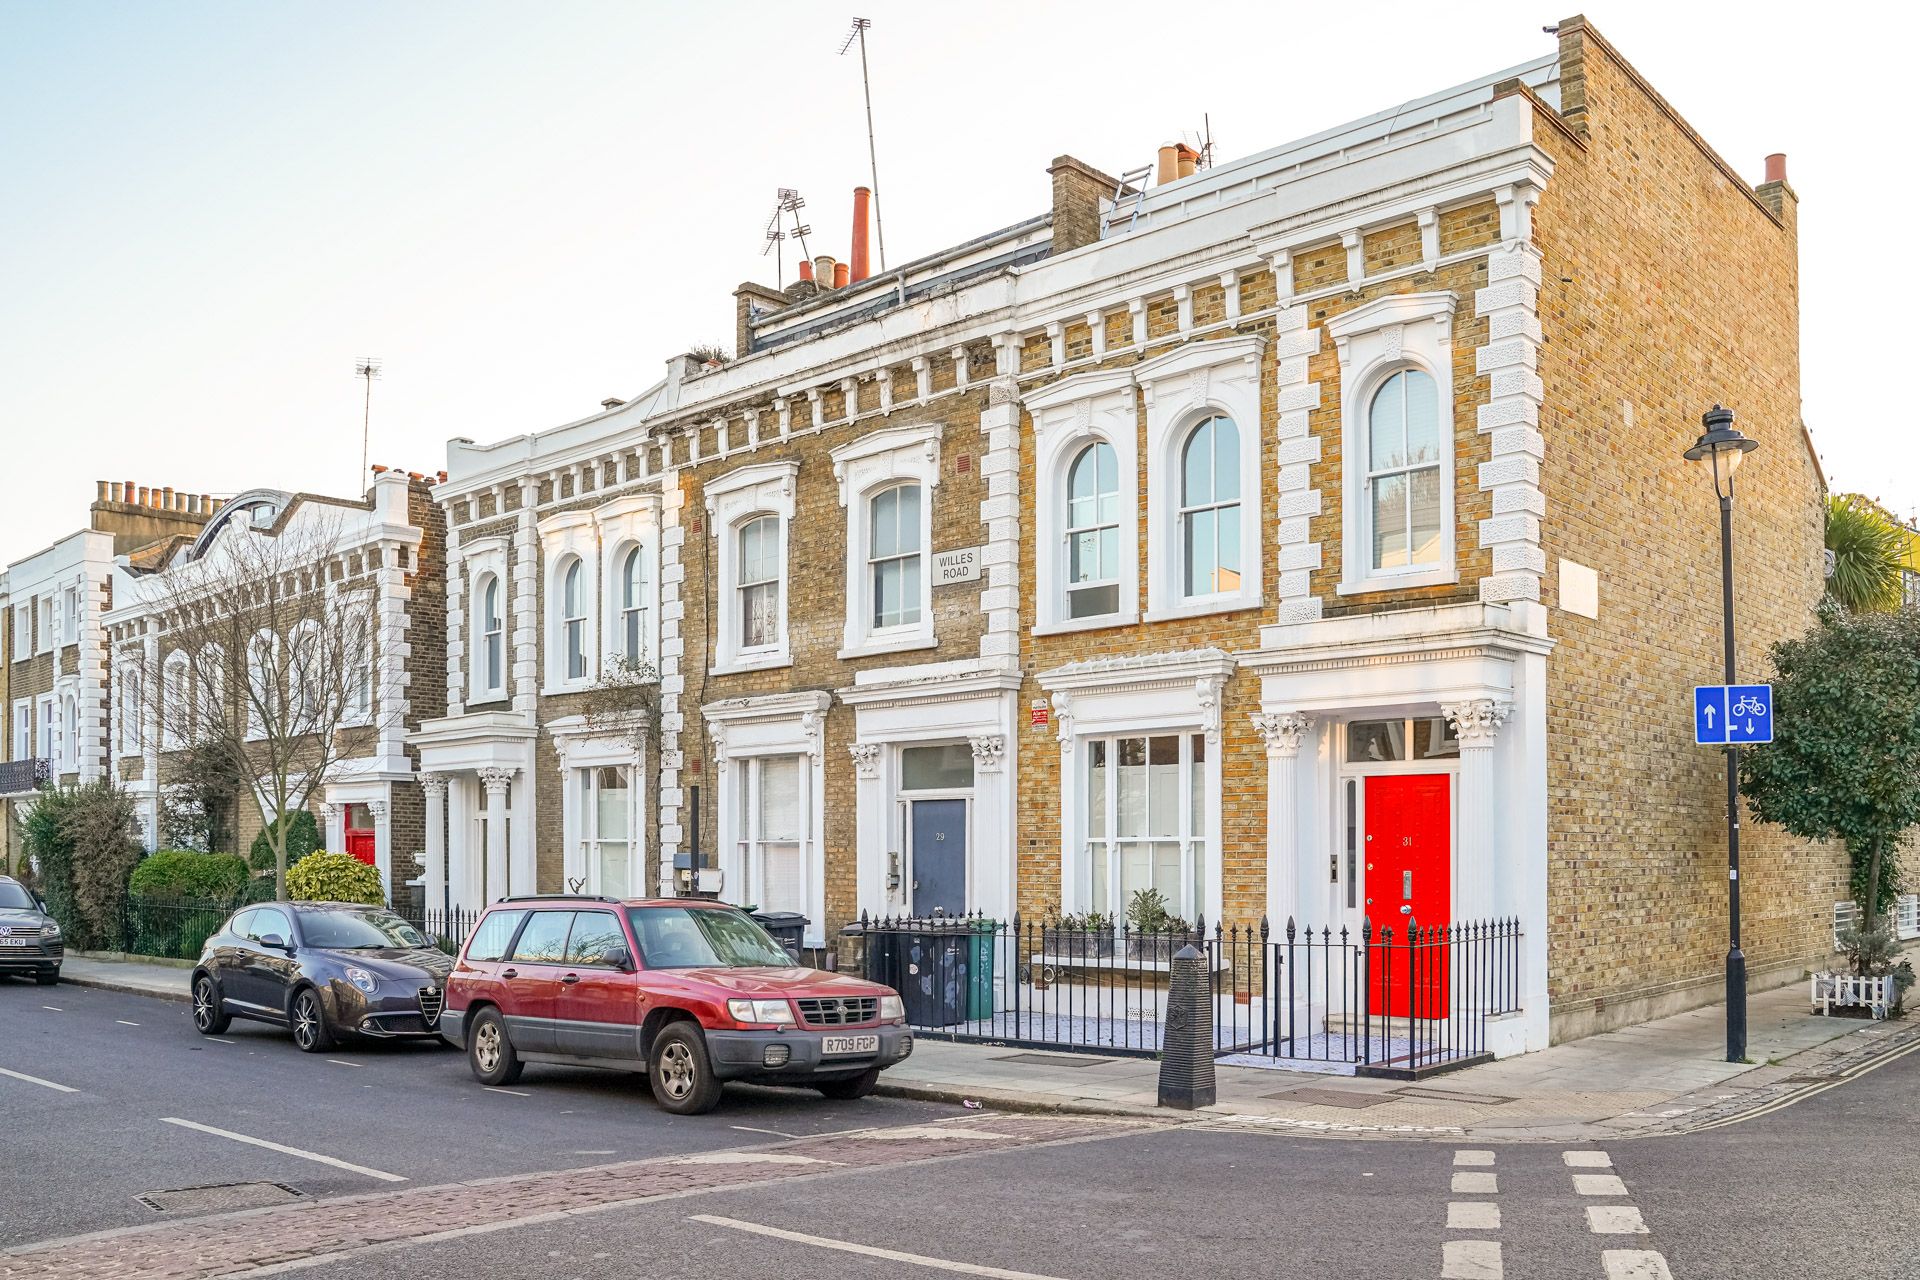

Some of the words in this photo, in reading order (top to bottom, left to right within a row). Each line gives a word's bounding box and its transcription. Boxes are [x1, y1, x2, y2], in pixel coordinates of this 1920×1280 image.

[939, 552, 973, 567] WILLES
[943, 566, 969, 579] ROAD
[936, 832, 945, 841] 29
[1402, 836, 1412, 846] 31
[827, 1038, 855, 1051] R709
[856, 1036, 876, 1050] FGP
